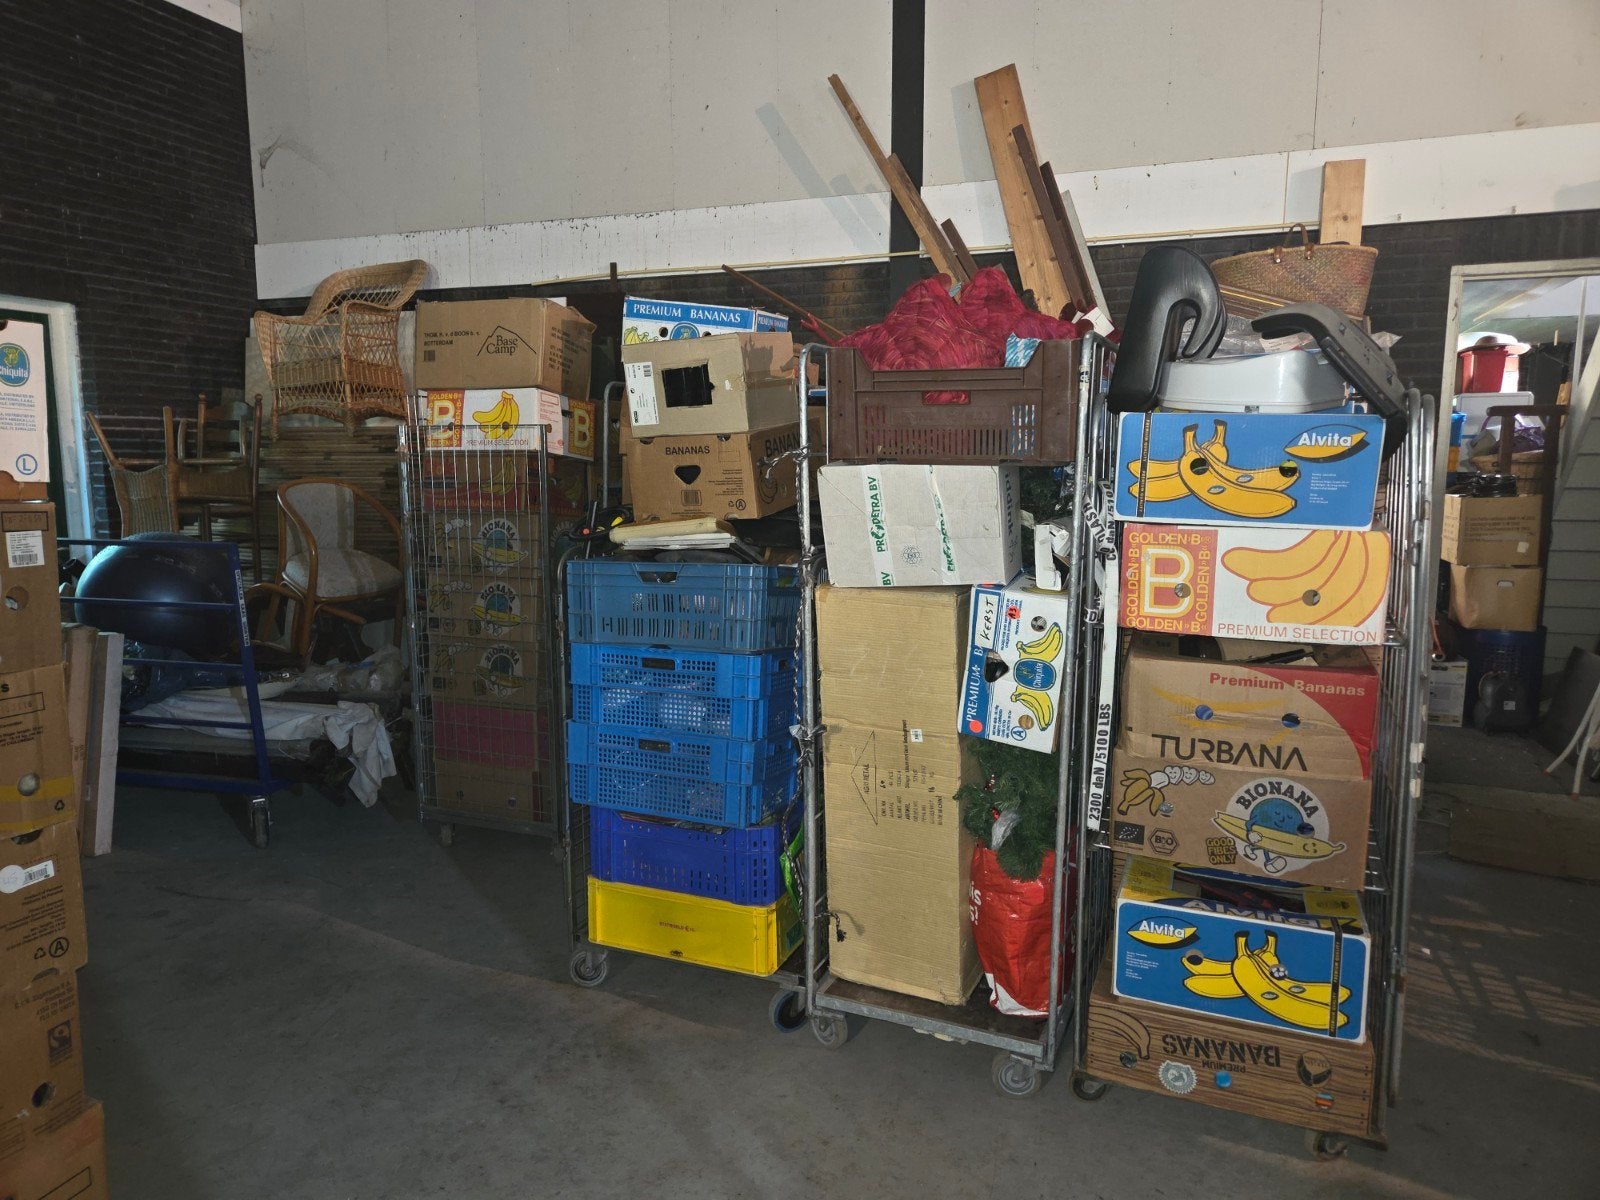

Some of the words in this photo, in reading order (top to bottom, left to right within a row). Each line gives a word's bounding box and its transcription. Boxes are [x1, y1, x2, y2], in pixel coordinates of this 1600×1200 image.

[633, 303, 682, 318] PREMIUM
[690, 309, 741, 323] BANANAS
[486, 343, 516, 356] Camp
[496, 335, 518, 346] Base
[433, 400, 455, 439] B
[574, 408, 590, 449] B
[765, 433, 801, 458] BANAN
[1298, 431, 1352, 448] Alvita
[665, 446, 710, 456] BANANAS
[23, 457, 31, 471] L
[867, 476, 878, 491] BV
[481, 520, 516, 539] BIONANA
[1129, 532, 1187, 545] GOLDEN
[880, 571, 891, 586] BV
[1139, 544, 1195, 618] B
[1127, 562, 1139, 618] GOLDEN
[1196, 566, 1210, 622] GOLDEN
[980, 597, 994, 642] KERST
[1126, 616, 1183, 631] GOLDEN
[1218, 623, 1287, 638] PREMIUM
[1292, 627, 1377, 642] SELECTION
[485, 647, 520, 666] BIONANA
[1032, 663, 1045, 689] Chiquita
[1209, 672, 1284, 690] Premium
[1293, 679, 1366, 697] Bananas
[965, 664, 981, 722] PREMIUM
[1097, 703, 1111, 727] LBS
[1015, 729, 1024, 738] A
[1094, 730, 1109, 764] /5100
[1152, 733, 1308, 772] TURBANA
[1091, 767, 1104, 789] daN
[1089, 793, 1102, 822] 2300
[1236, 781, 1319, 818] BIONANA
[1206, 837, 1236, 847] GOOD
[1209, 854, 1237, 865] ONLY
[1139, 920, 1185, 938] Alvita
[54, 941, 65, 954] A
[1162, 1034, 1281, 1068] BANANAS
[1202, 1060, 1247, 1074] PREMIUM
